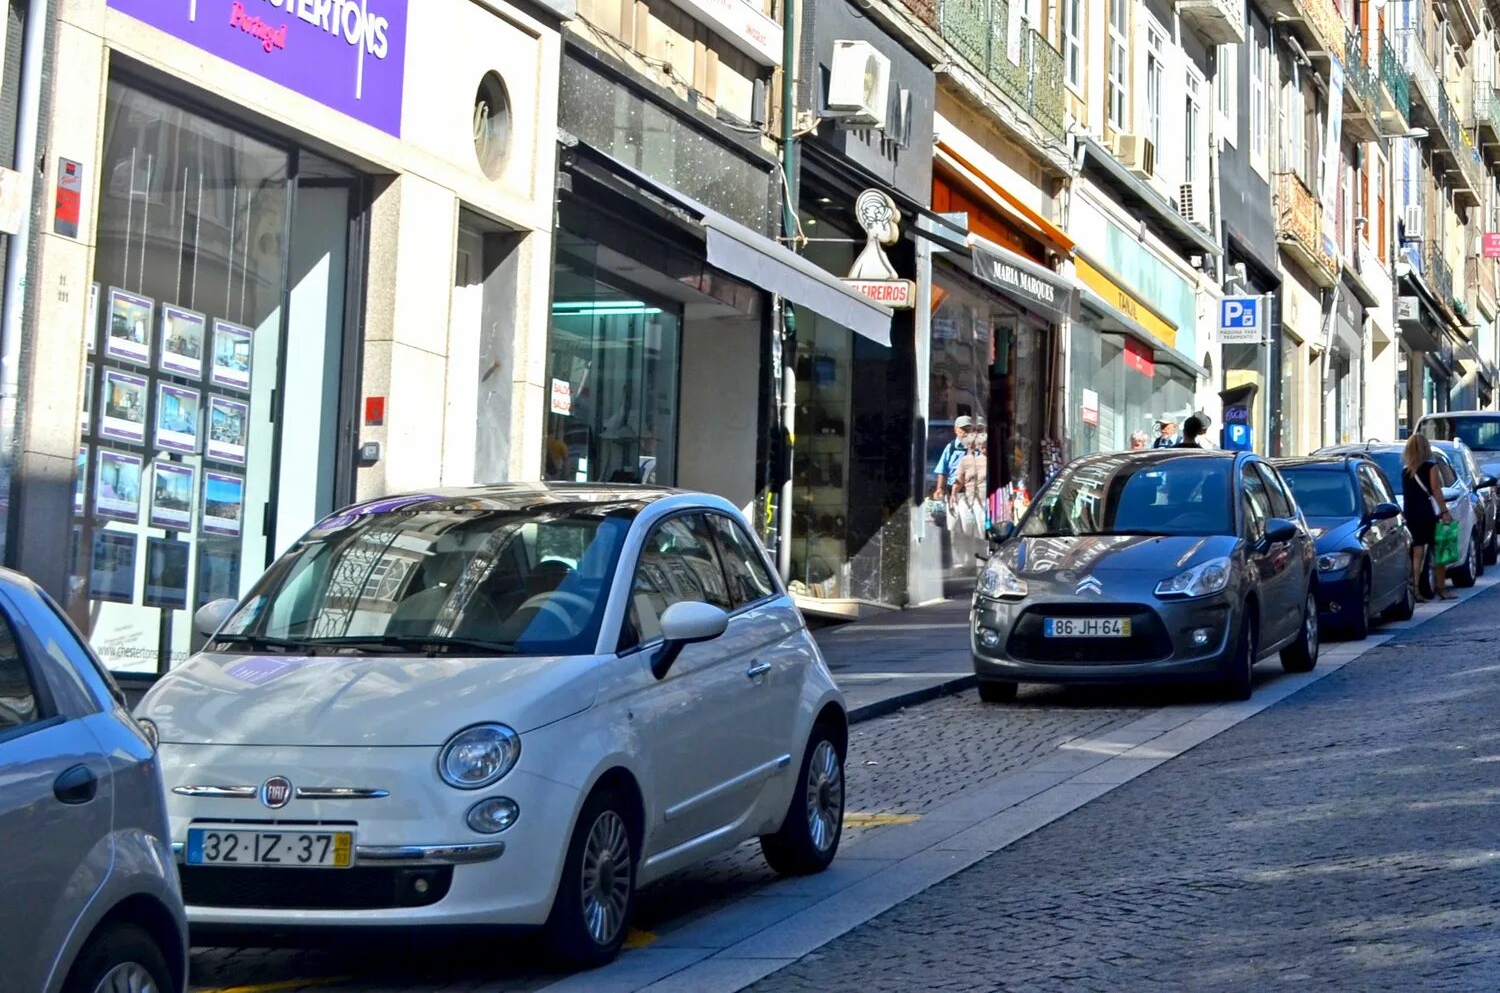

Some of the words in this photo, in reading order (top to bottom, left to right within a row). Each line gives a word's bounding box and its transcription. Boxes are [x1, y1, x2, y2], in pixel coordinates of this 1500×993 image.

[230, 0, 288, 53] Portugal
[993, 260, 1019, 287] MARIA
[1019, 271, 1055, 303] MARQUES
[1225, 301, 1243, 326] P
[1233, 426, 1244, 442] P
[267, 785, 287, 800] FIAT
